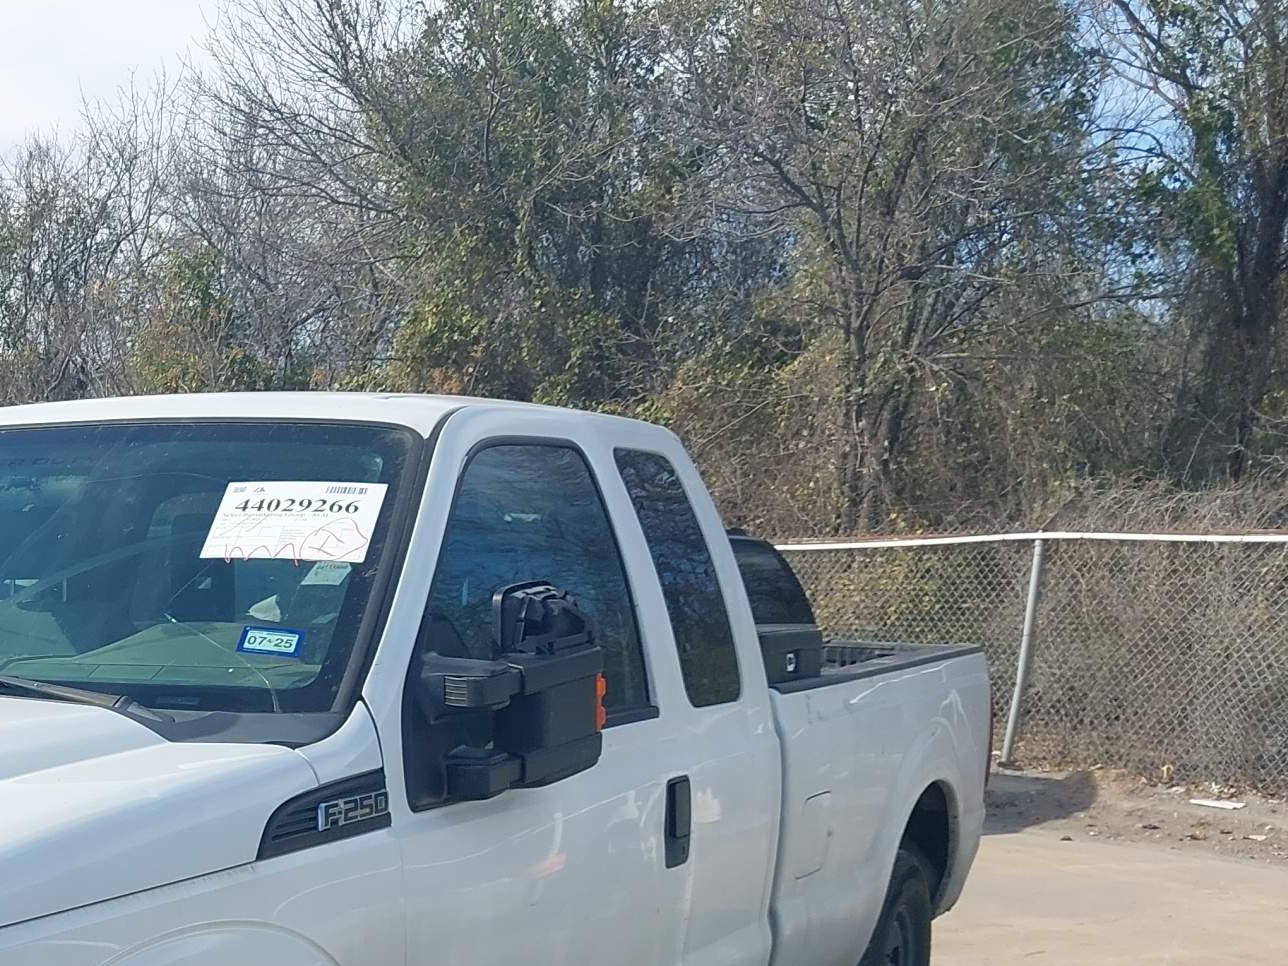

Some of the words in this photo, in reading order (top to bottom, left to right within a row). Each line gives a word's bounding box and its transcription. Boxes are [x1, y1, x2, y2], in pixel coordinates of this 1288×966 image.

[234, 497, 361, 514] 44029266
[247, 635, 267, 646] 07
[273, 637, 294, 649] 25
